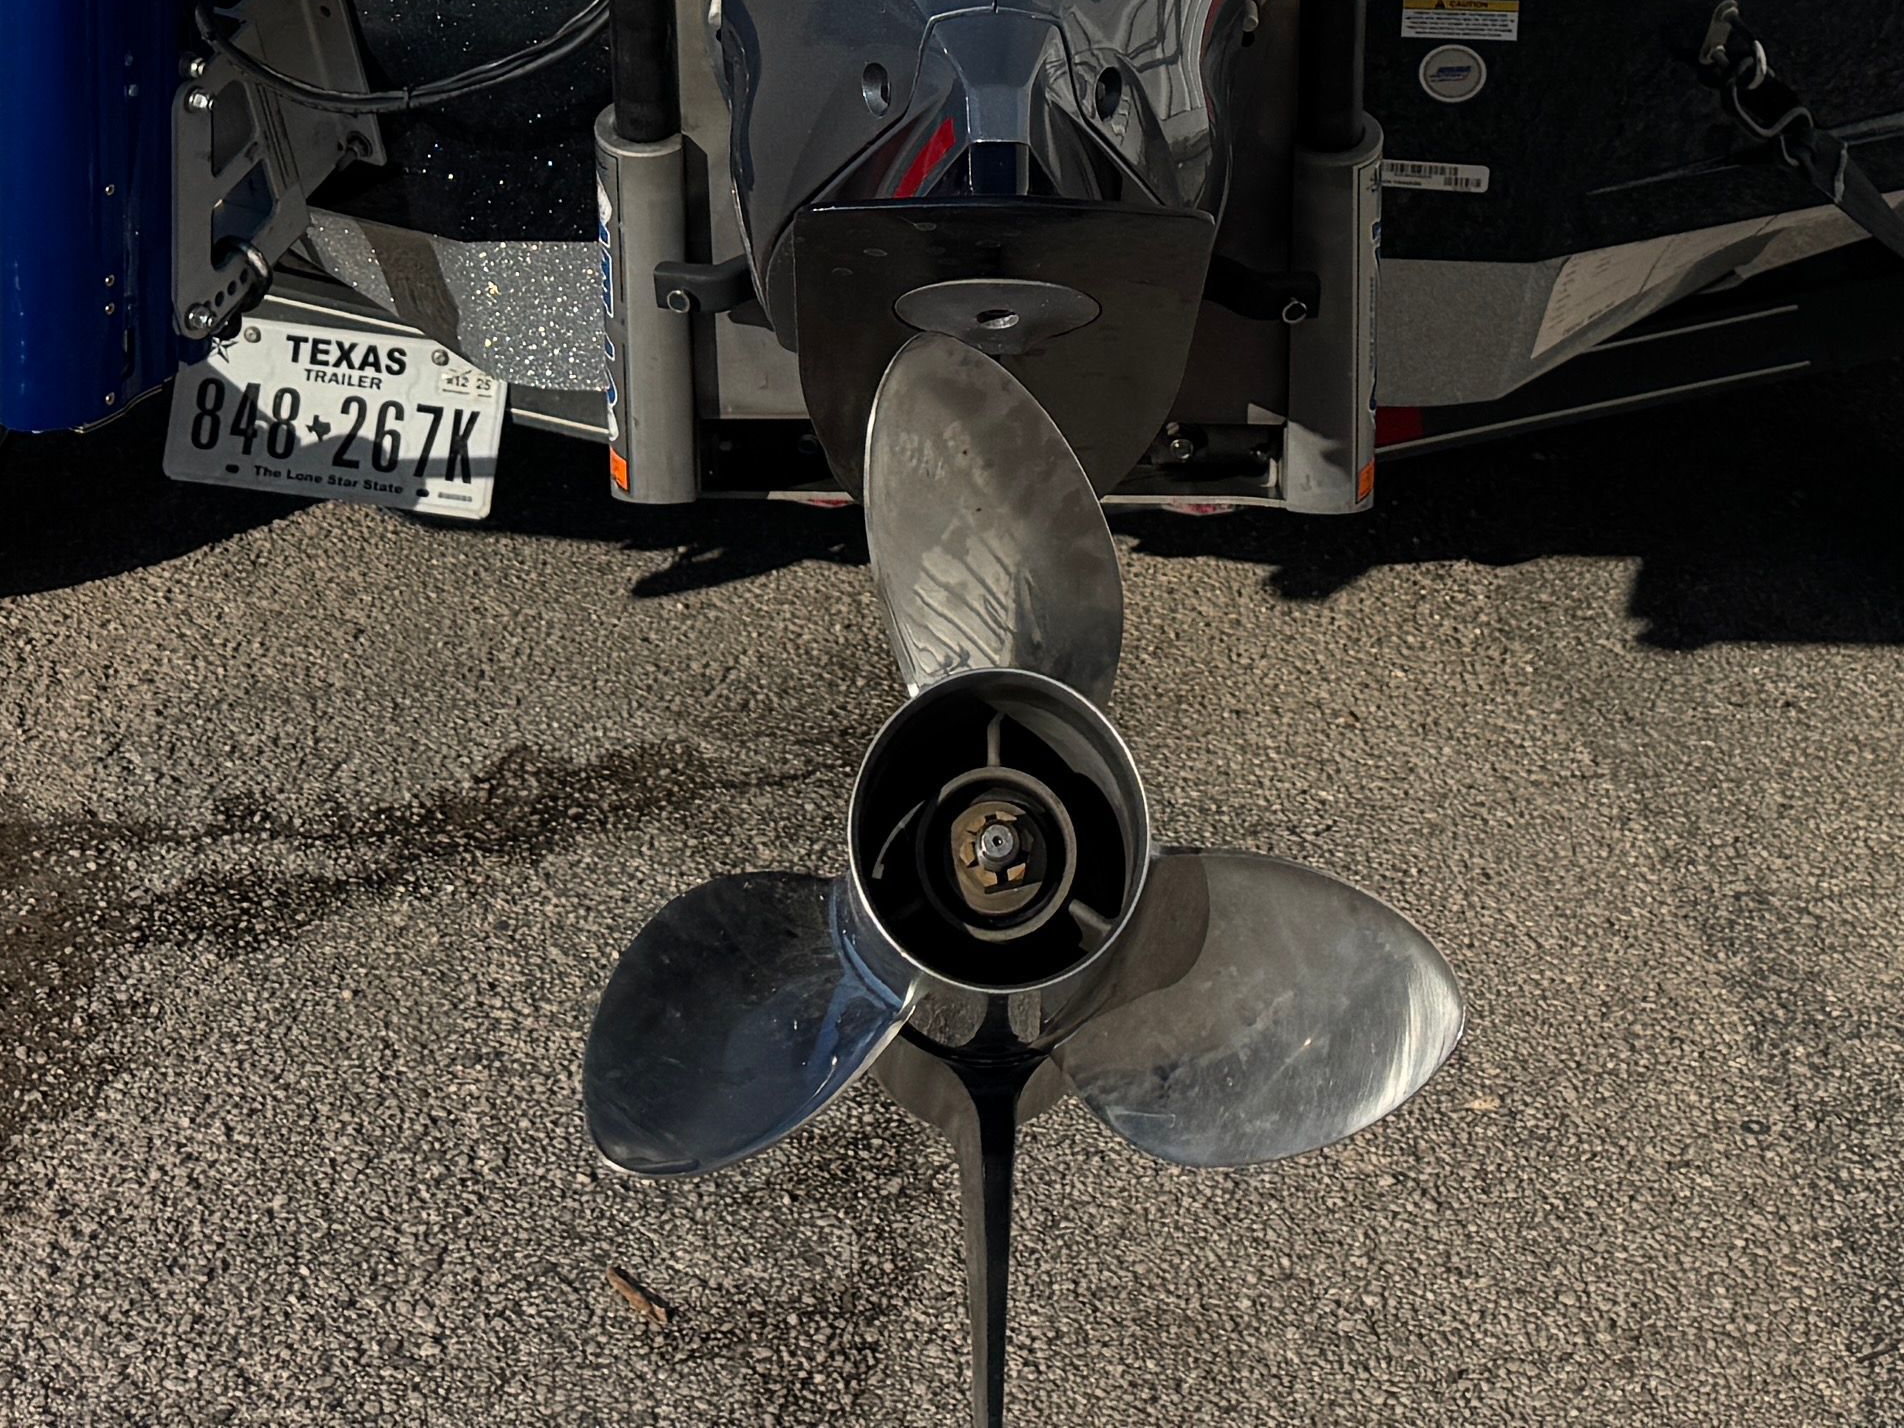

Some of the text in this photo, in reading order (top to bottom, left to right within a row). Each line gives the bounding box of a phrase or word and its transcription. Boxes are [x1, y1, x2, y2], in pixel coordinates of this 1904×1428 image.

[1448, 0, 1489, 9] CAUTION
[285, 334, 408, 376] TEXAS
[303, 367, 384, 392] TRAILER
[476, 377, 492, 391] 25
[190, 377, 481, 484] 848 267K
[254, 464, 404, 495] The Lone Star State
